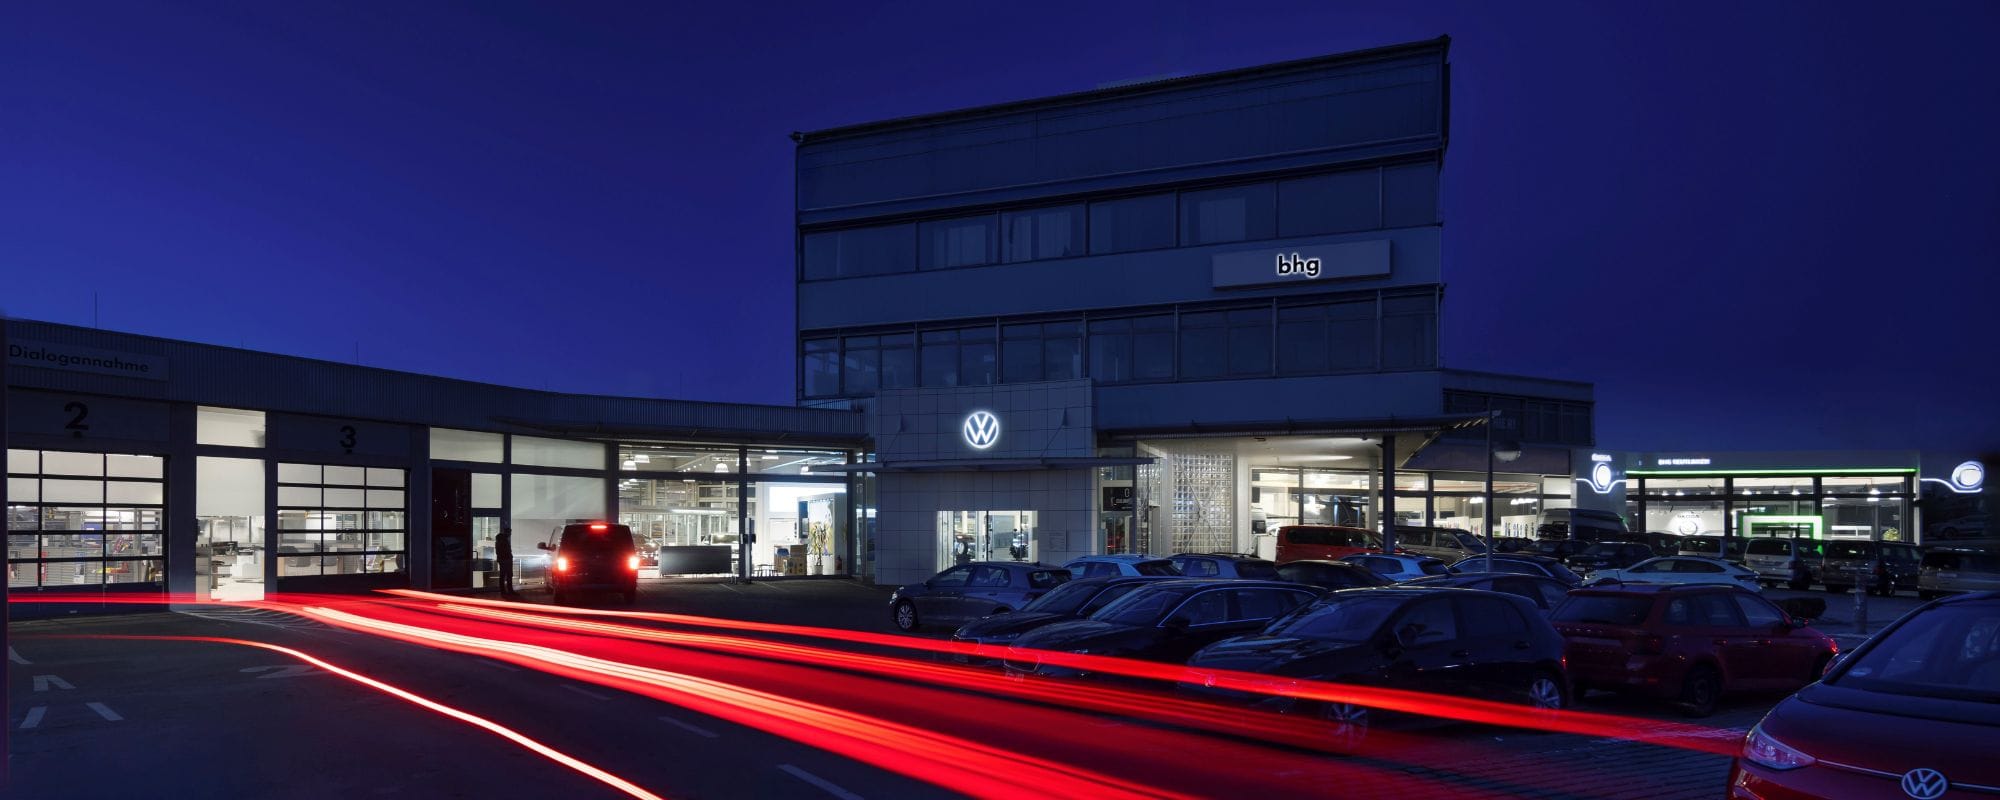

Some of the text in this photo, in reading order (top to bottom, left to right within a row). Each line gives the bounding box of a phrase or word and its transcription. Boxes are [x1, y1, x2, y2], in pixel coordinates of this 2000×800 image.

[1278, 254, 1320, 277] bhg
[9, 344, 149, 373] Dialogannahme
[64, 401, 89, 430] 2
[964, 411, 999, 449] VW
[340, 426, 356, 448] 3
[1901, 768, 1948, 799] VW
